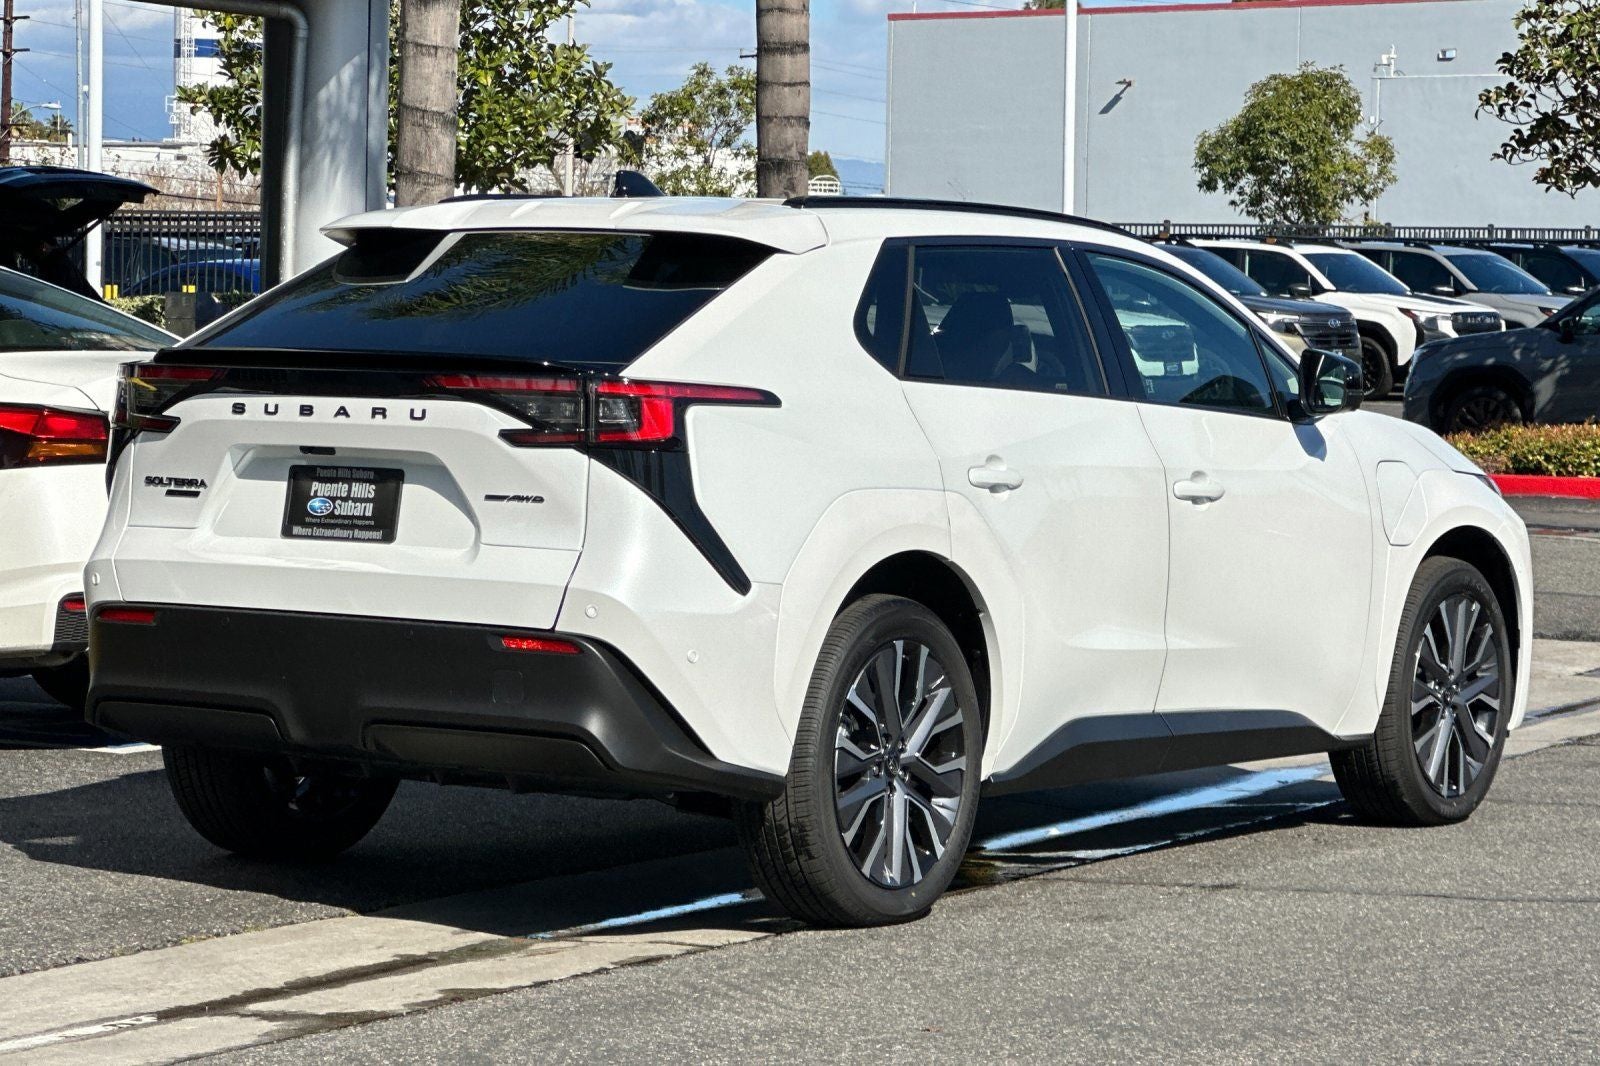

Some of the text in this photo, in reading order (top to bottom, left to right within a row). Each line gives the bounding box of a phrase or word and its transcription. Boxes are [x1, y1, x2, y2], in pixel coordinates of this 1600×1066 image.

[231, 402, 427, 421] SUBARU
[352, 468, 375, 480] Subaru
[144, 475, 208, 489] SOLTERRA
[310, 481, 376, 498] Puente Hills
[506, 495, 545, 503] AWD
[334, 500, 373, 517] Subaru
[292, 525, 383, 540] Where Extraordinary Happens!
